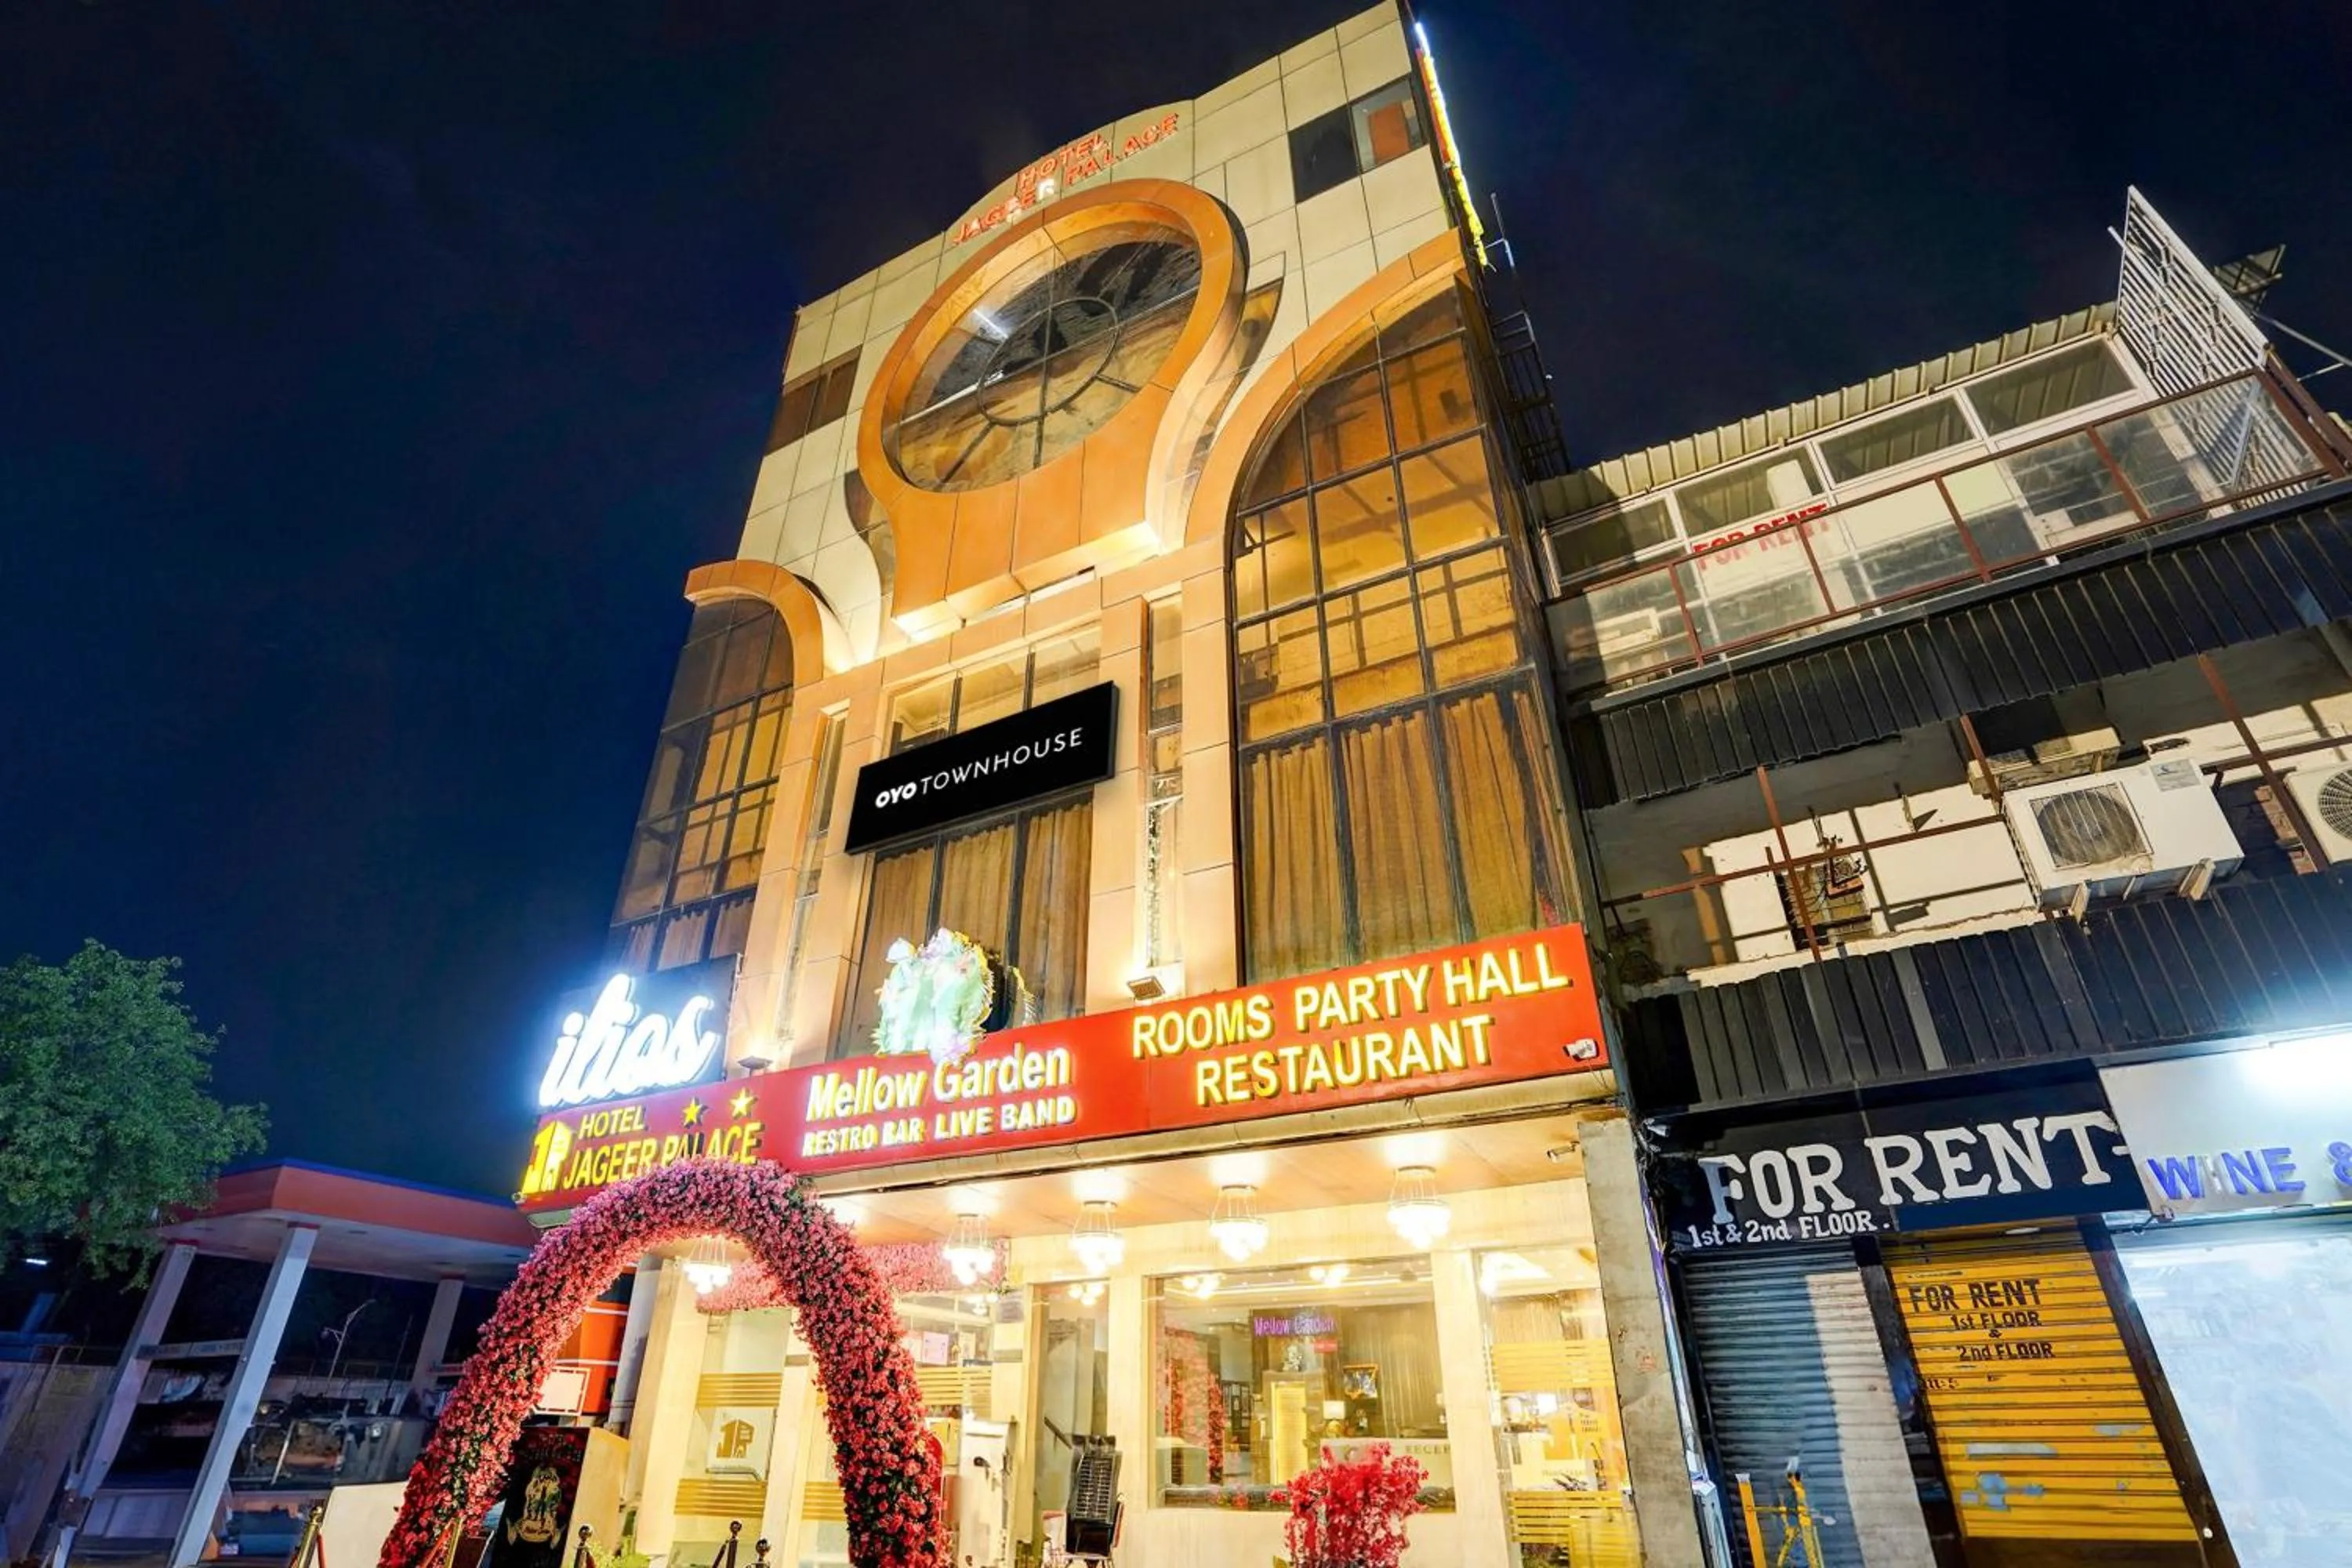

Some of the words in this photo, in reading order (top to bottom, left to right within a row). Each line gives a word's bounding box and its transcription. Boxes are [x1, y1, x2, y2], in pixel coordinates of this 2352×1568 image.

[1019, 133, 1112, 189] HOTEL
[1064, 113, 1179, 186] PALACE
[875, 781, 918, 809] OYO
[920, 727, 1084, 796] TOWNHOUSE
[1132, 994, 1275, 1058] ROOMS
[1294, 964, 1434, 1033] PARTY
[1442, 942, 1573, 1007] HALL
[805, 1066, 928, 1123] Mellow
[933, 1042, 1073, 1102] Garden
[1196, 1014, 1494, 1108] RESTAURANT
[579, 1105, 646, 1140] HOTEL
[802, 1123, 878, 1157] RESTRO
[881, 1117, 926, 1147] BAR
[933, 1107, 995, 1140] LIVE
[1000, 1095, 1077, 1131] BAND
[563, 1137, 659, 1189] JAGEER
[1698, 1144, 1856, 1224] FOR
[1688, 1224, 1723, 1249] 1st
[1725, 1223, 1743, 1244] &
[1745, 1221, 1791, 1243] 2nd
[1908, 1283, 1960, 1313] FOR
[1968, 1279, 2040, 1308] RENT
[1950, 1312, 1974, 1330] 1st
[1980, 1310, 2042, 1330] FLOOR
[1957, 1344, 1992, 1362] 2nd
[1994, 1341, 2056, 1362] FLOOR
[1988, 1328, 2002, 1338] &
